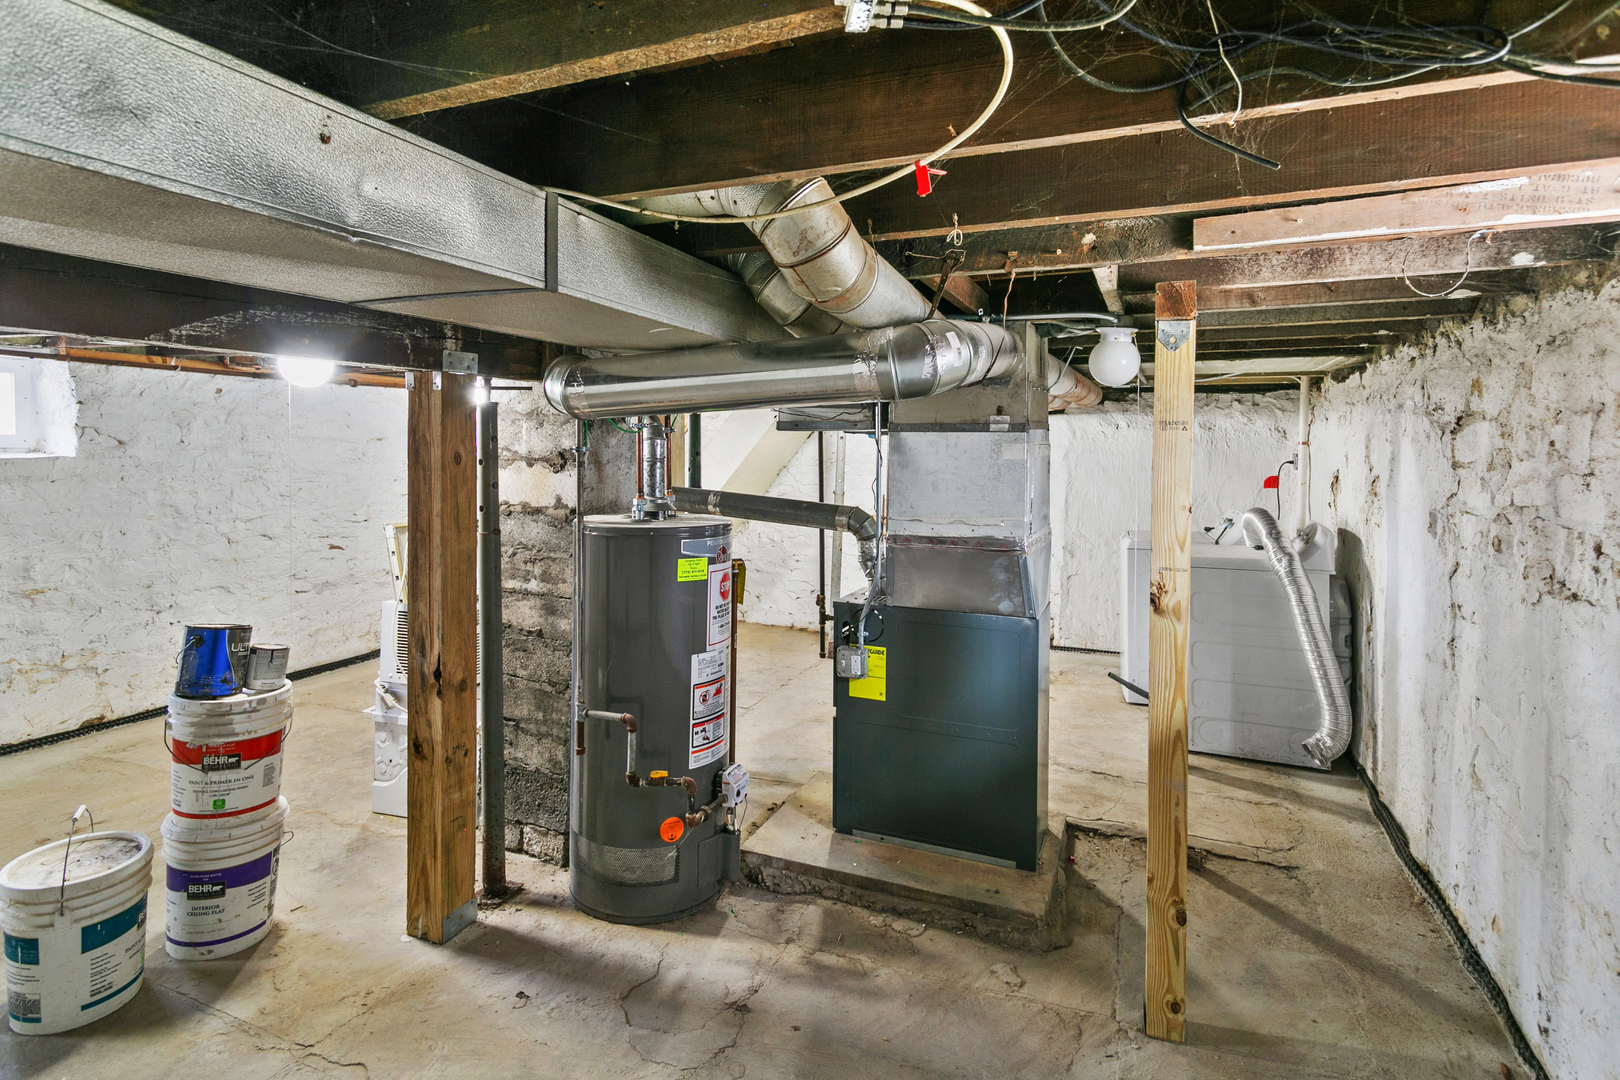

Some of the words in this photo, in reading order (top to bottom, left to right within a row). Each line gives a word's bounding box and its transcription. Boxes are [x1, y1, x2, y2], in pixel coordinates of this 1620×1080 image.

[1499, 193, 1546, 203] UNITS
[203, 755, 229, 765] BEHR
[210, 778, 233, 786] PRIMER
[188, 884, 212, 894] BEHR
[211, 907, 226, 915] FLAT
